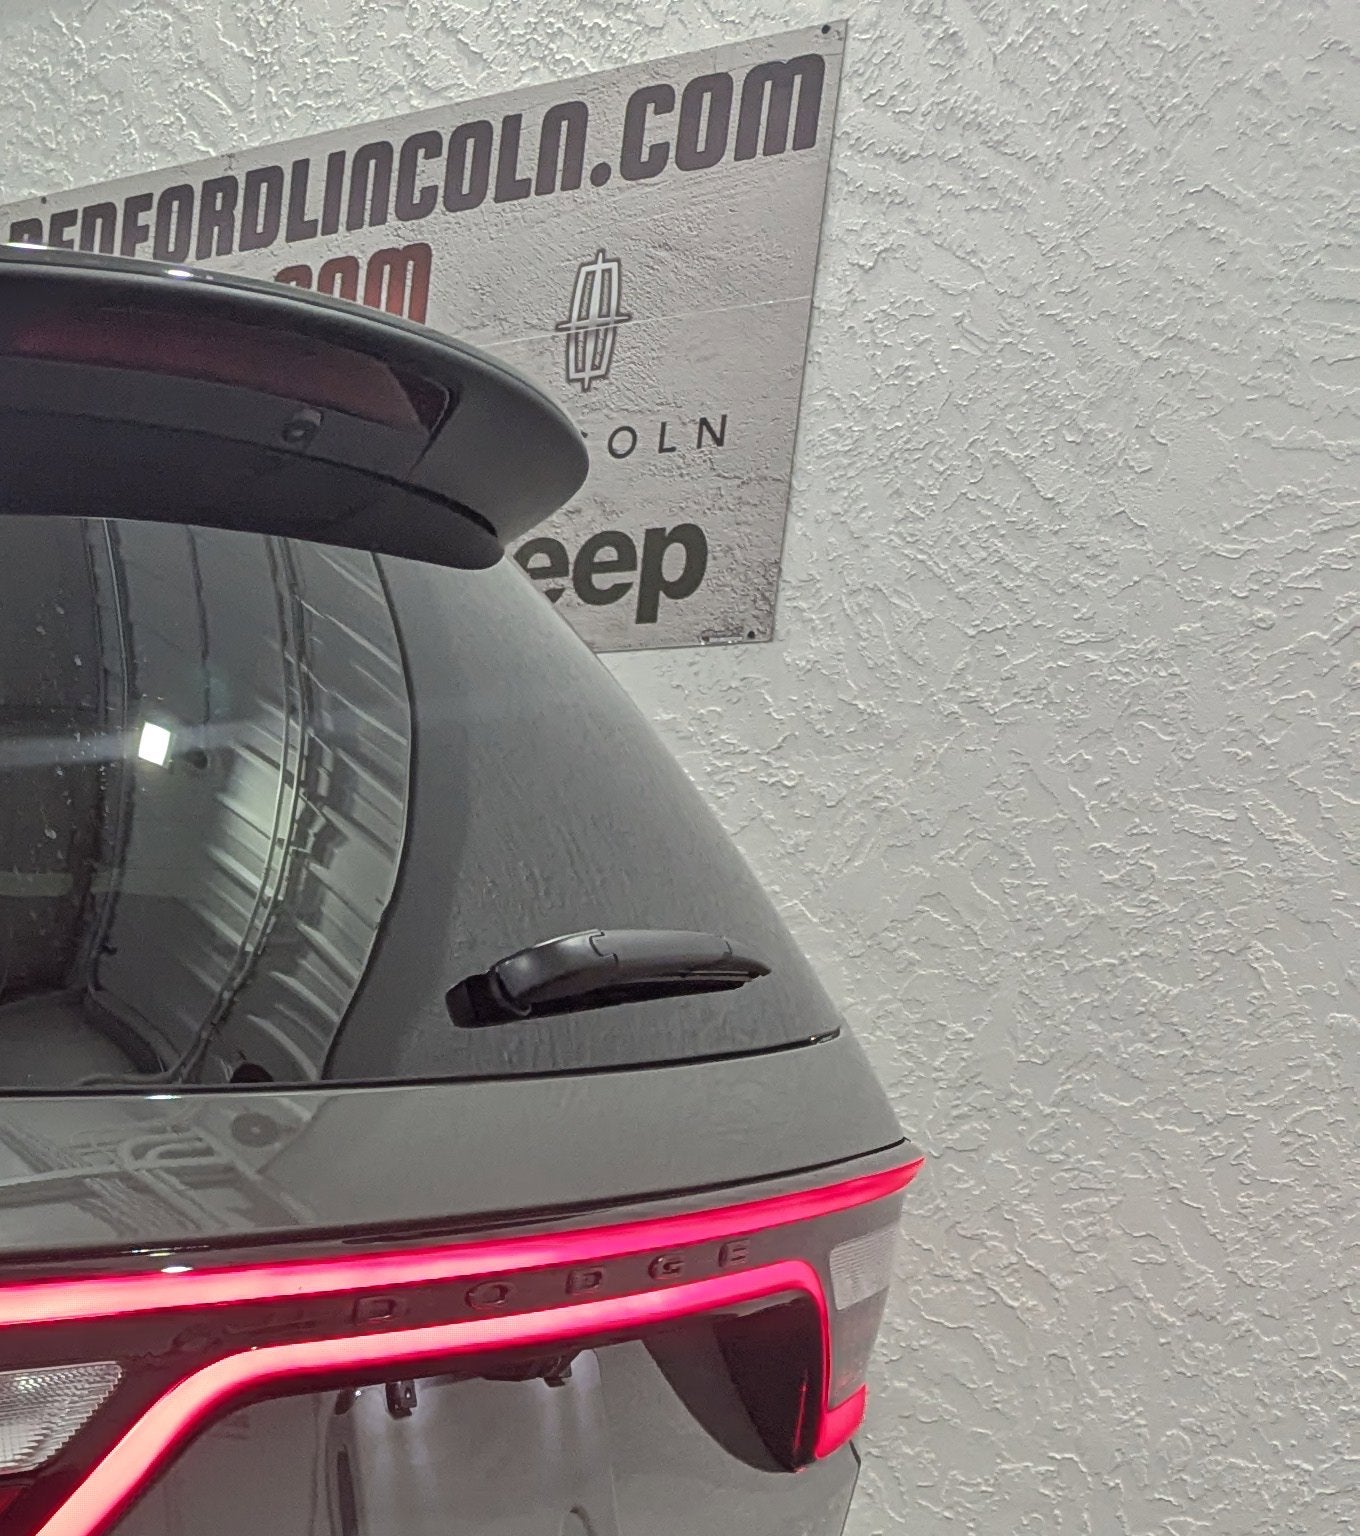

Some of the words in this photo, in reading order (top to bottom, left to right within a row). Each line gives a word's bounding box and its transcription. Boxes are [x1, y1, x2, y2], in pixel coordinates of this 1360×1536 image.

[581, 414, 728, 460] OLN
[513, 523, 708, 625] eep
[352, 1239, 751, 1324] DODGE
